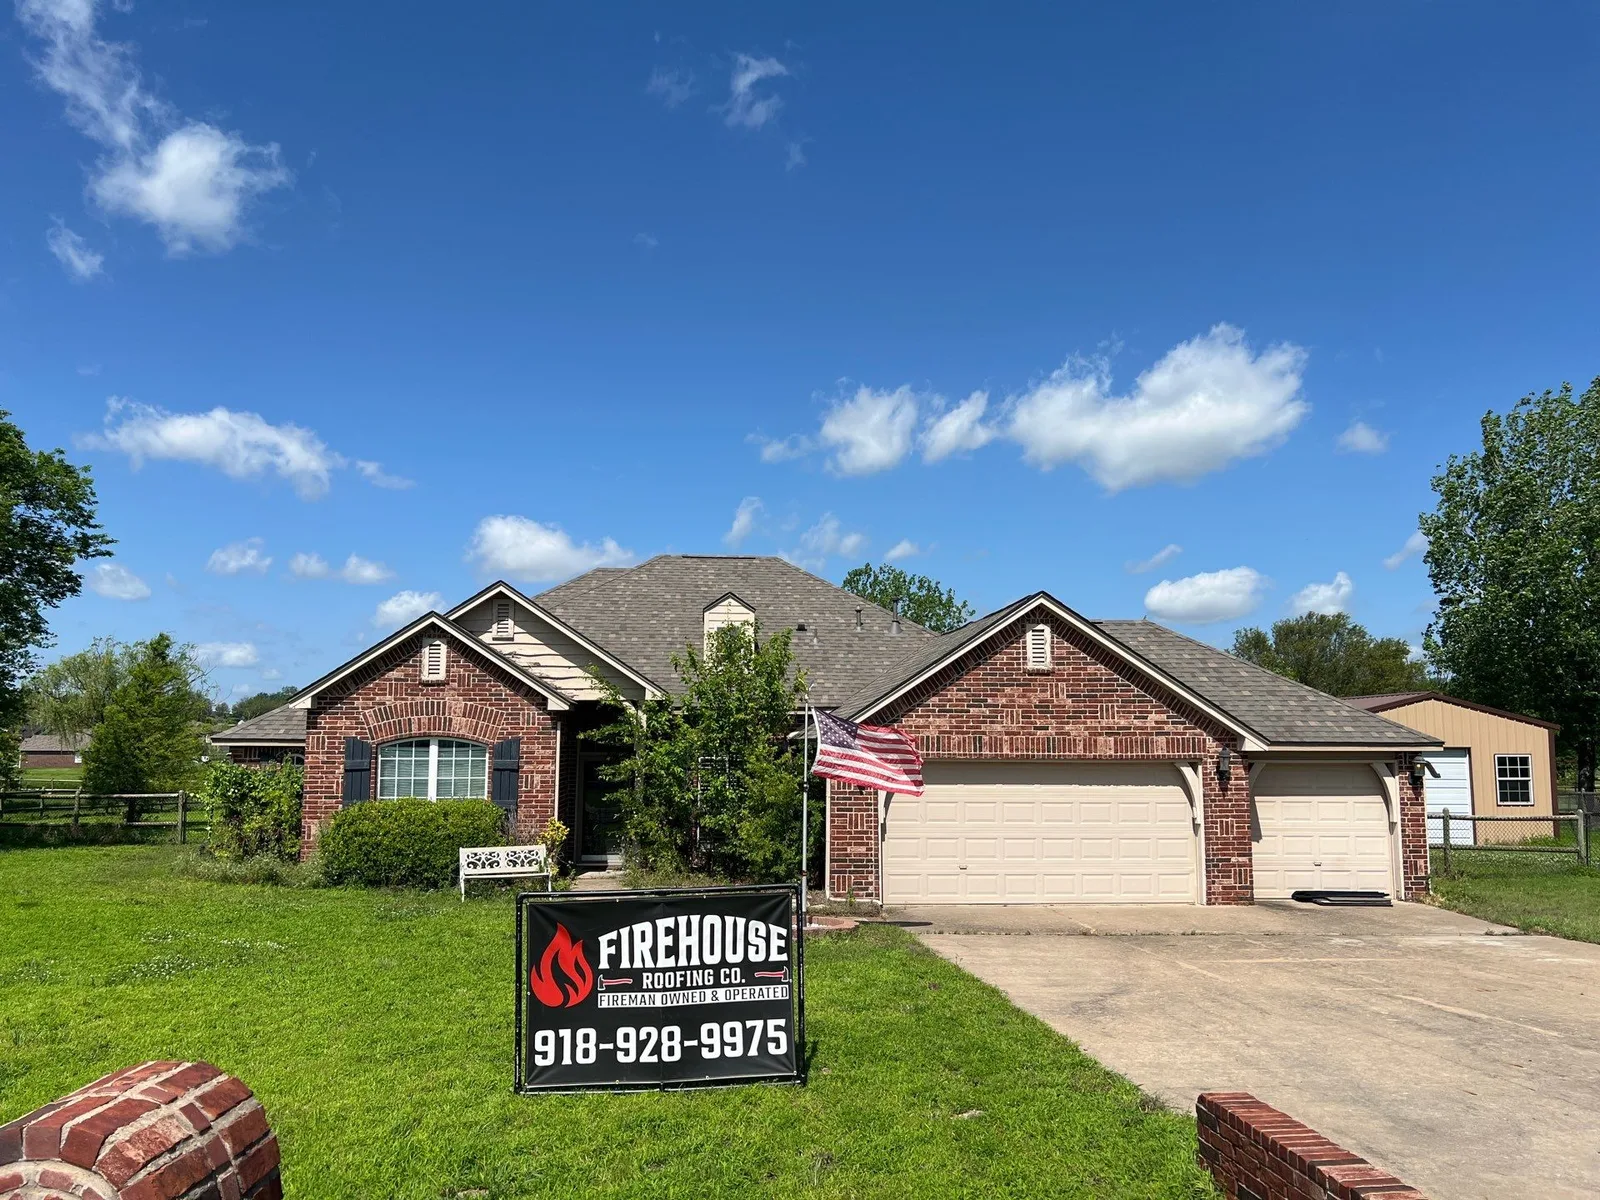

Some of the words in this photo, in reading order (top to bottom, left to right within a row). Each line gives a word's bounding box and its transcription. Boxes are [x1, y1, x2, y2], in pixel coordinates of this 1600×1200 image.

[598, 914, 788, 969] FIREHOUSE
[642, 969, 713, 989] ROOFING
[720, 967, 746, 985] CO.
[599, 993, 656, 1006] FIREMAN
[661, 991, 706, 1004] OWNED
[711, 989, 719, 1002] &
[726, 986, 788, 1001] OPERATED
[534, 1018, 788, 1067] 918-928-9975
